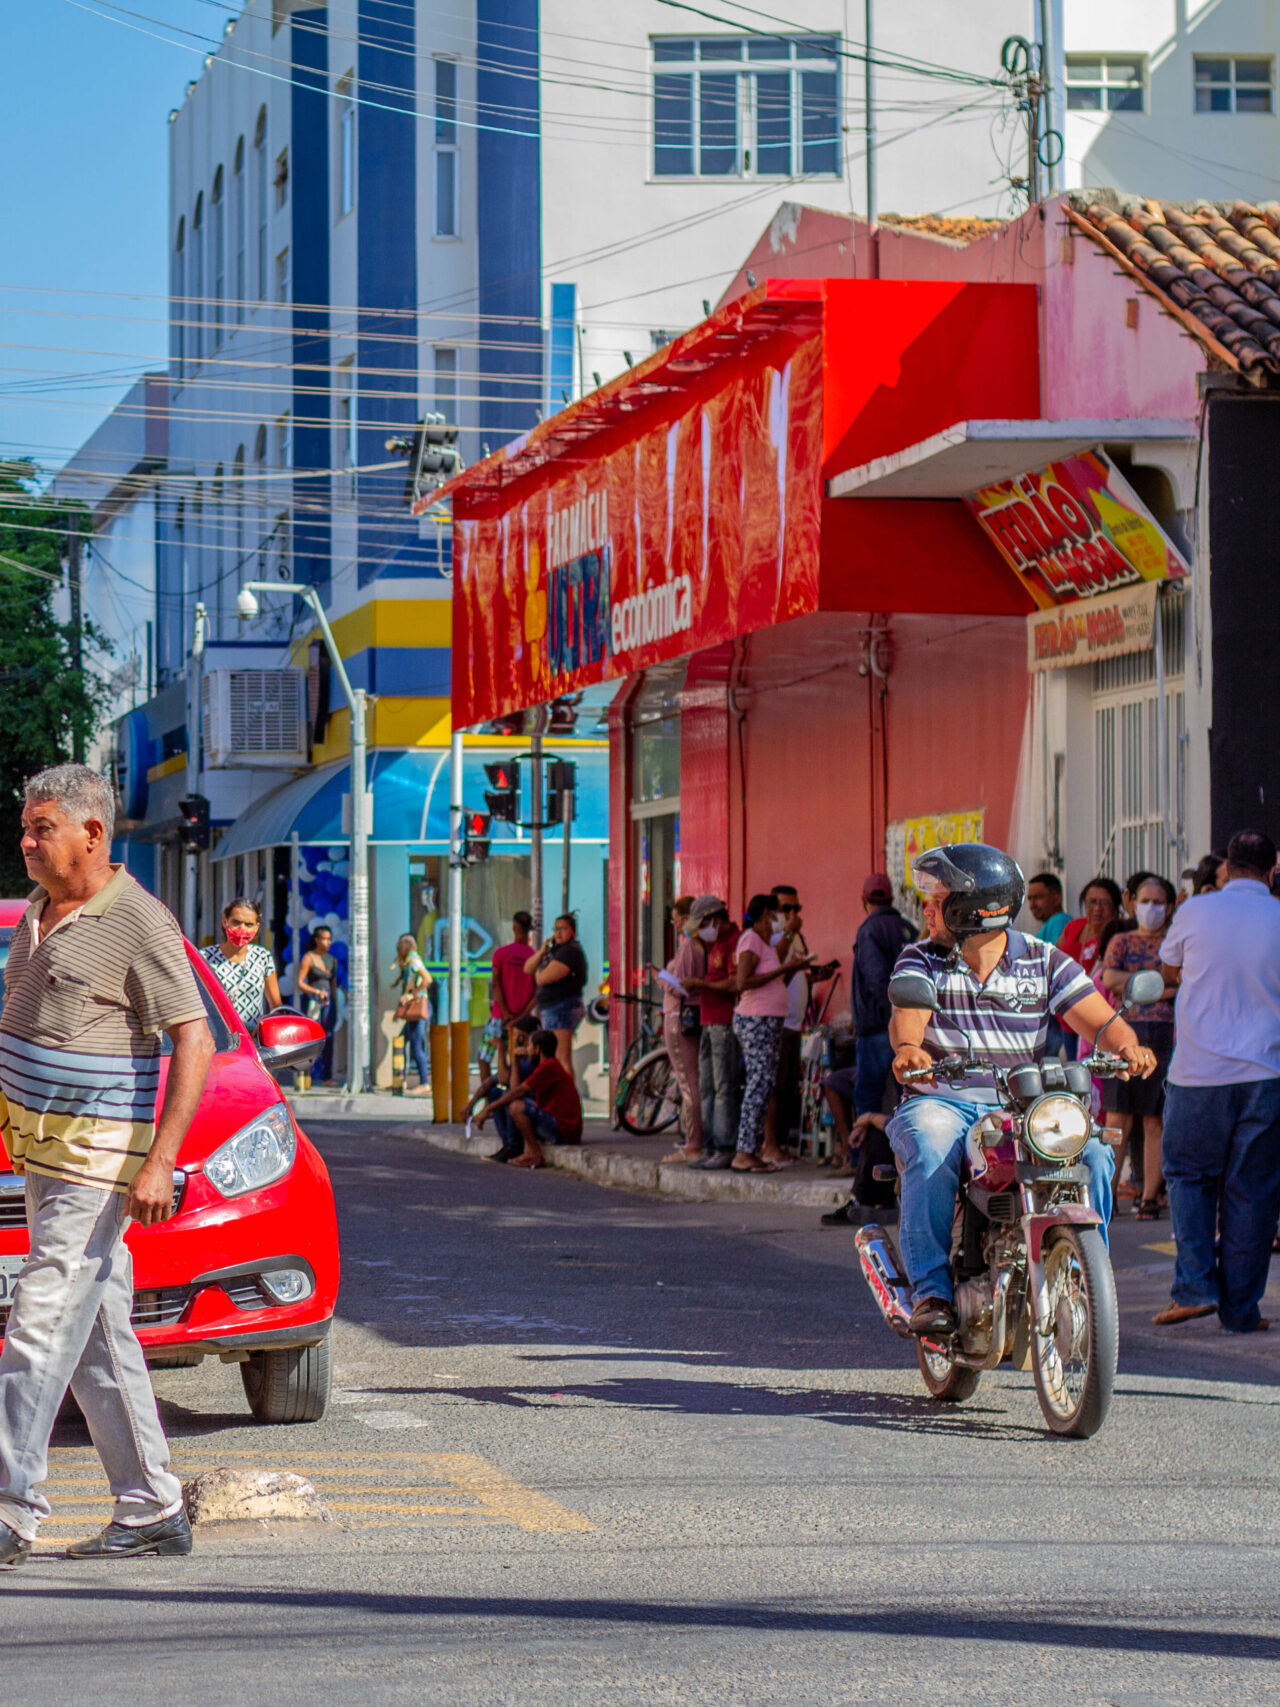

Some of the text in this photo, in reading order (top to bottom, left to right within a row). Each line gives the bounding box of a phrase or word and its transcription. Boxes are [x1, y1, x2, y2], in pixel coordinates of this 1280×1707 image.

[1056, 530, 1141, 598] MODA
[548, 545, 613, 678] ULTRA
[1045, 1168, 1073, 1179] YAMAHA
